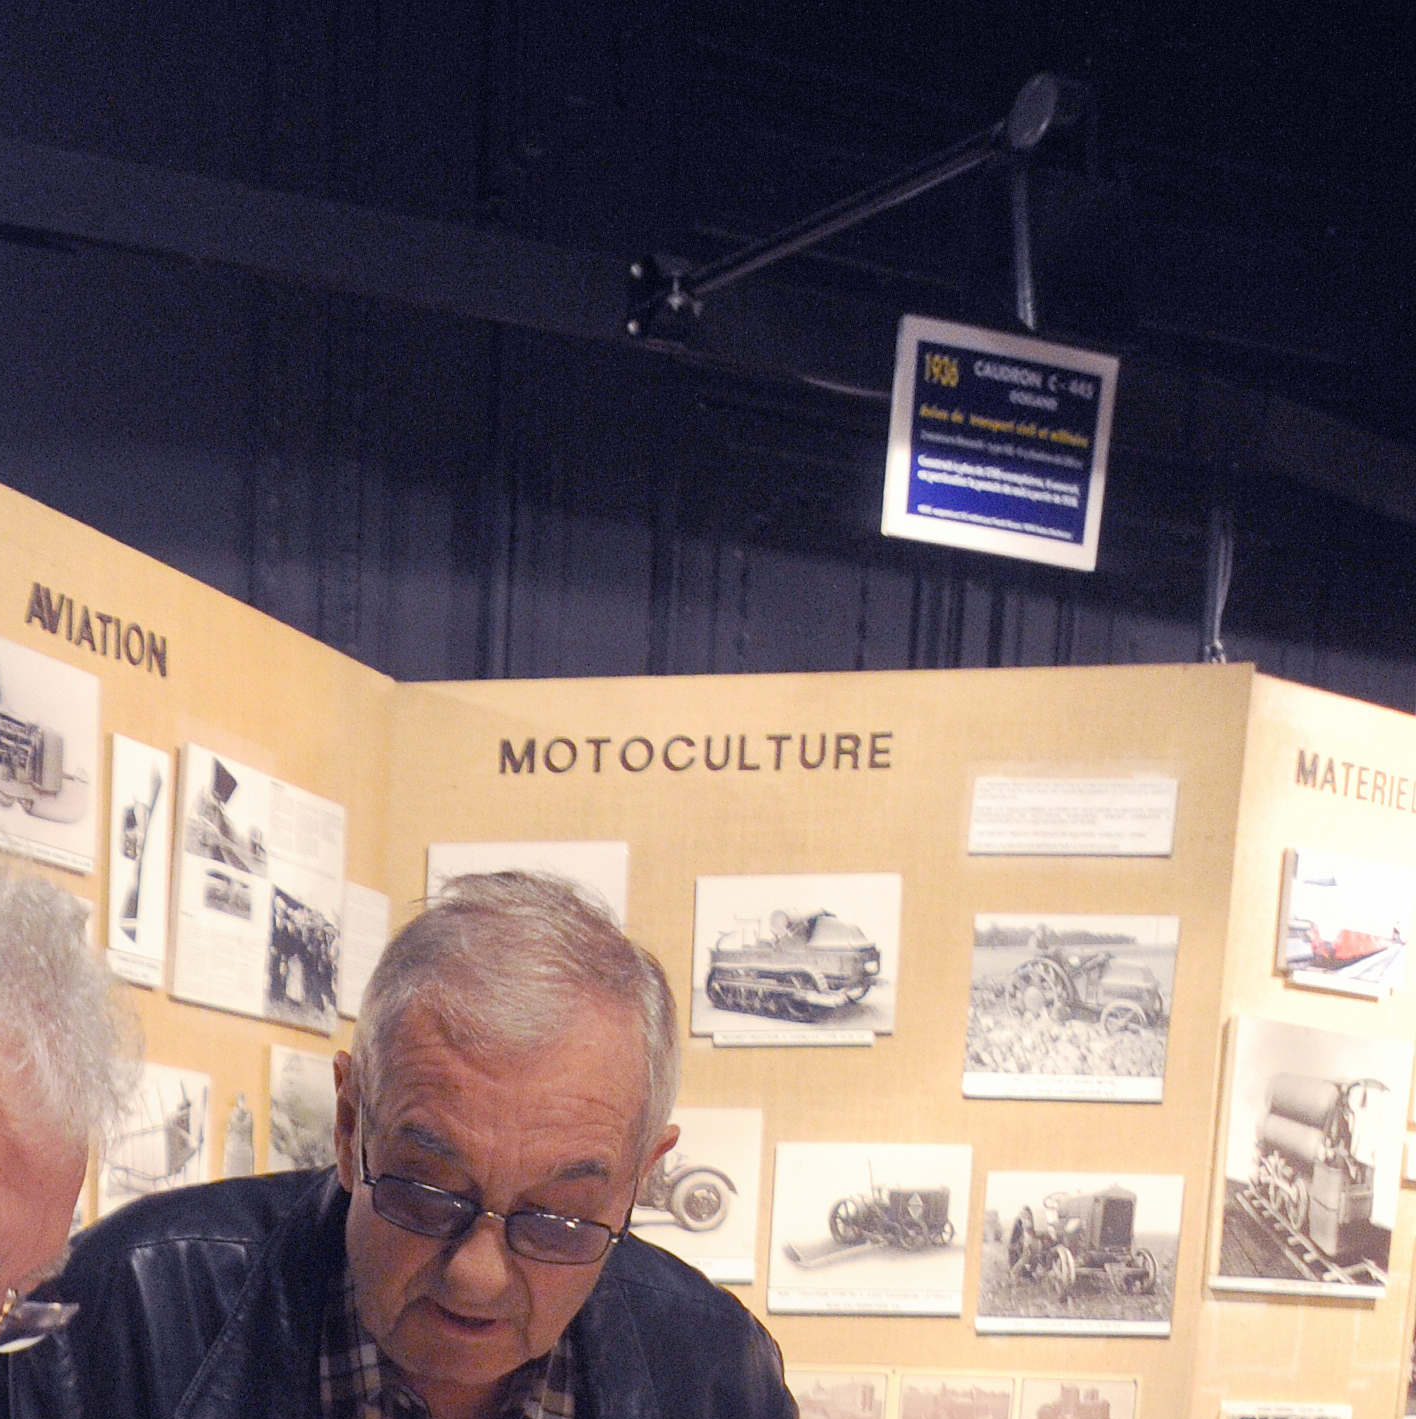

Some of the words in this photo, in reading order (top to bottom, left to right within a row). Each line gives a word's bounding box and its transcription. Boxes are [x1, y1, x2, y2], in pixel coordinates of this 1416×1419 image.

[925, 354, 959, 388] 1936
[973, 360, 1043, 388] CAUDRON
[25, 582, 167, 677] AVIATION
[498, 731, 893, 774] MOTOCULTURE
